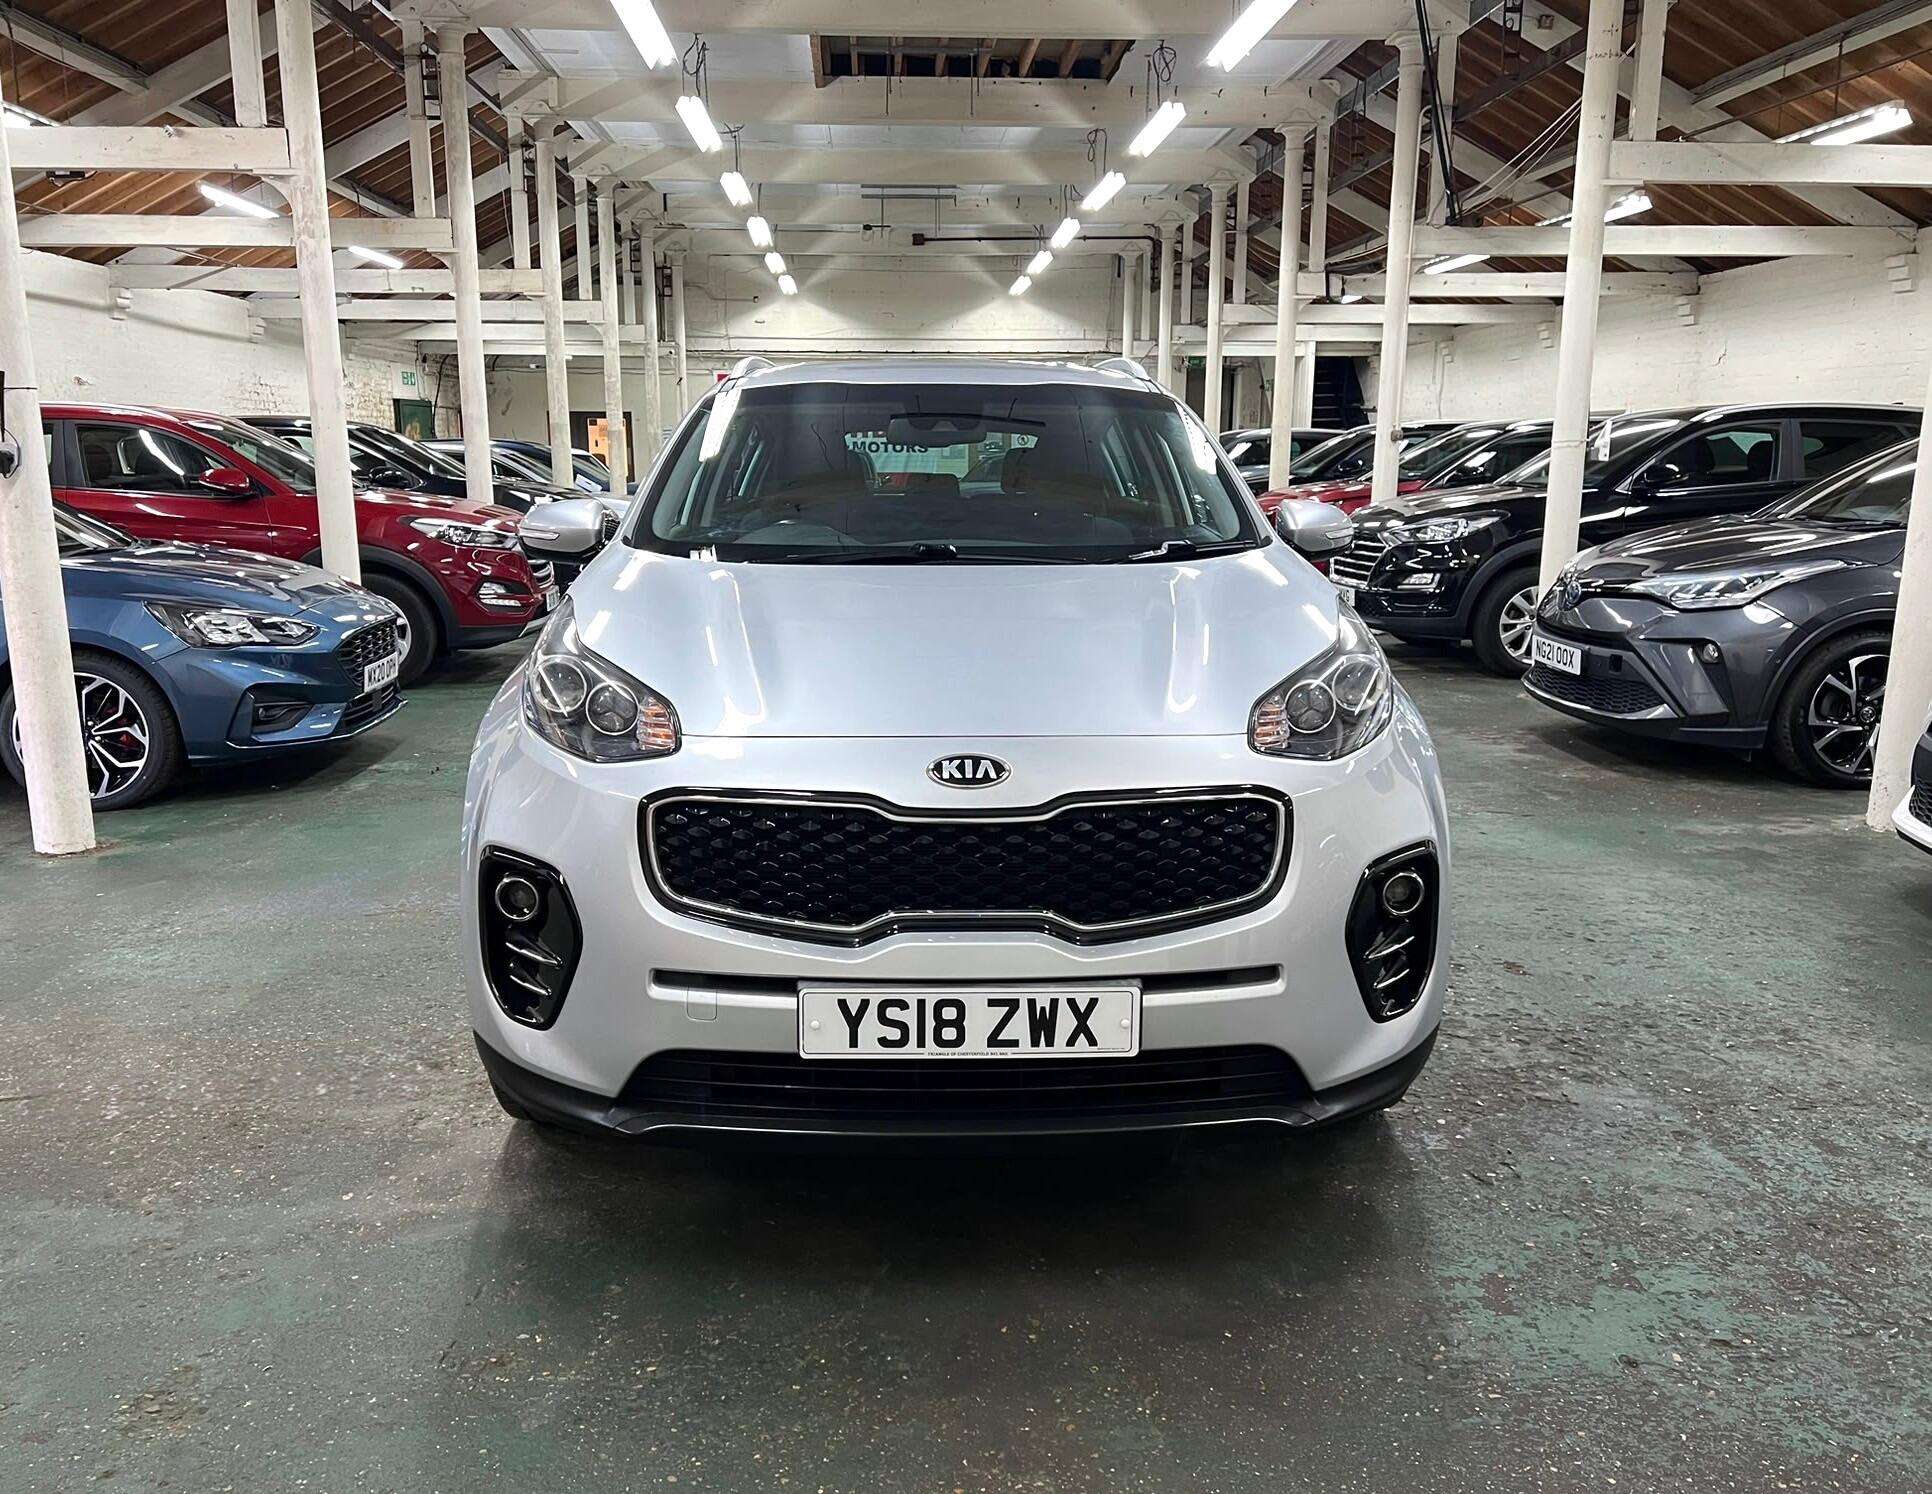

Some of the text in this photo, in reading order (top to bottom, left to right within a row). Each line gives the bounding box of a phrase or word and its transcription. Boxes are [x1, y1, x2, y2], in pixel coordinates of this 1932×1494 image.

[852, 440, 929, 454] MOTORS
[1535, 639, 1555, 662] NG21
[941, 759, 997, 779] KIA
[837, 997, 1099, 1048] YS18 ZWX
